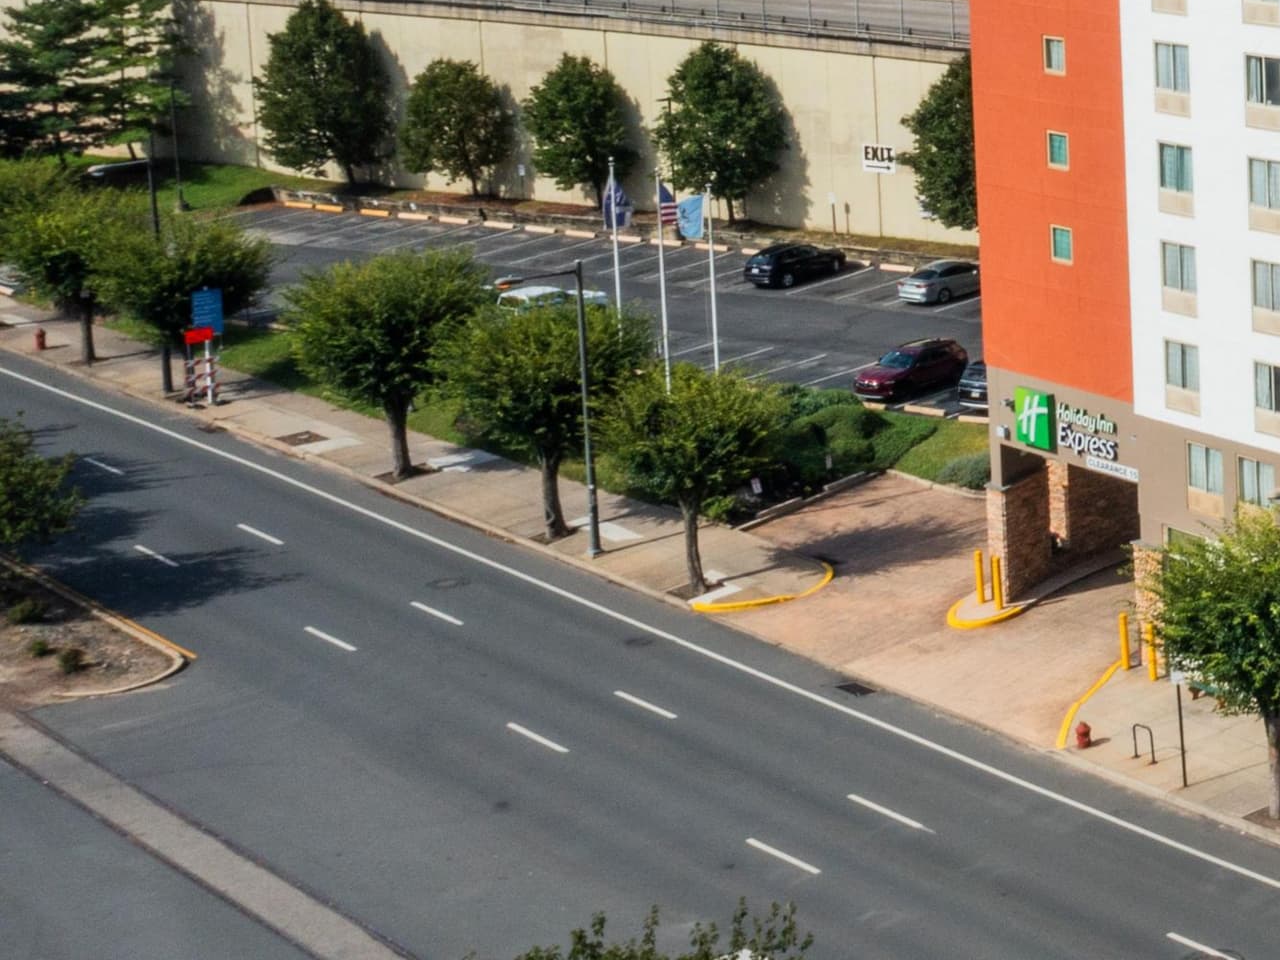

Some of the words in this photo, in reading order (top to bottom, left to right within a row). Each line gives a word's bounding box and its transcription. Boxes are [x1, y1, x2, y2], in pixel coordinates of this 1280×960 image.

[864, 145, 893, 163] EXIT
[1056, 403, 1096, 433] Holiday
[1096, 413, 1114, 434] Inn
[1057, 422, 1116, 460] Express
[1087, 458, 1128, 476] CLEARANCE
